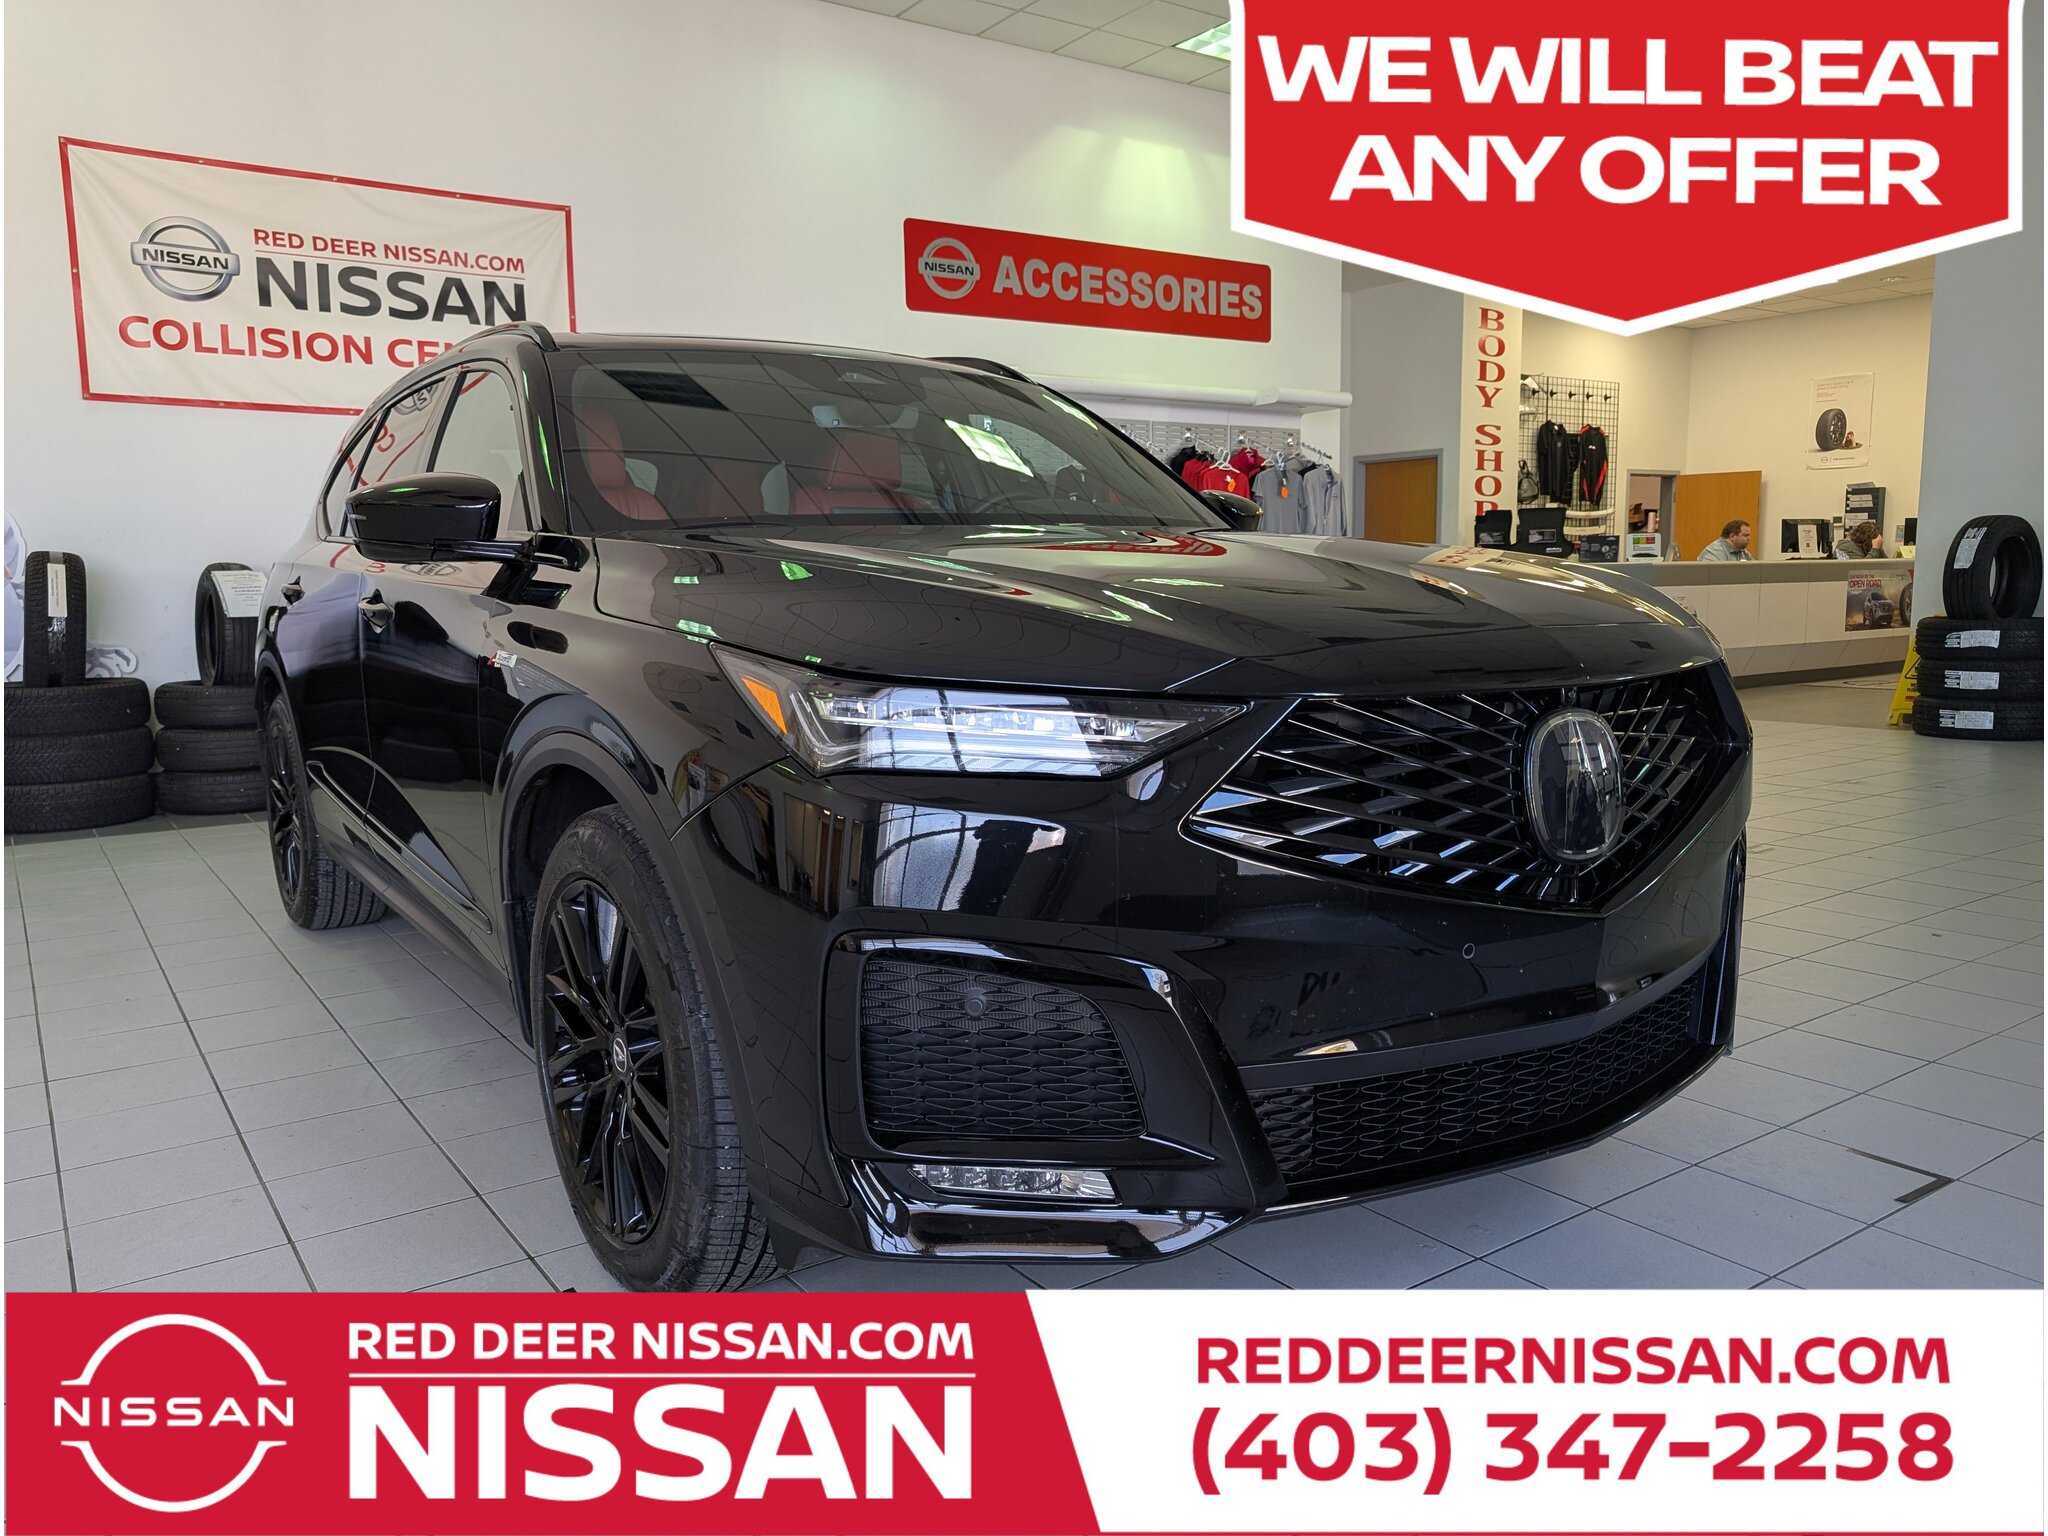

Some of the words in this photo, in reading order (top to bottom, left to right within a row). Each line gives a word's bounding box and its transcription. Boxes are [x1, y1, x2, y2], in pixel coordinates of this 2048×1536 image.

[142, 248, 229, 270] NISSAN
[253, 228, 305, 249] RED
[312, 236, 377, 258] DEER
[383, 244, 525, 273] NISSAN.COM
[924, 261, 975, 277] NISSAN
[256, 257, 527, 326] NISSAN
[993, 255, 1264, 320] ACCESSORIES
[118, 315, 374, 366] COLLISION
[387, 338, 459, 368] CE
[1475, 306, 1506, 409] BODY
[1849, 580, 1865, 588] OPEN
[1866, 579, 1882, 588] ROAD
